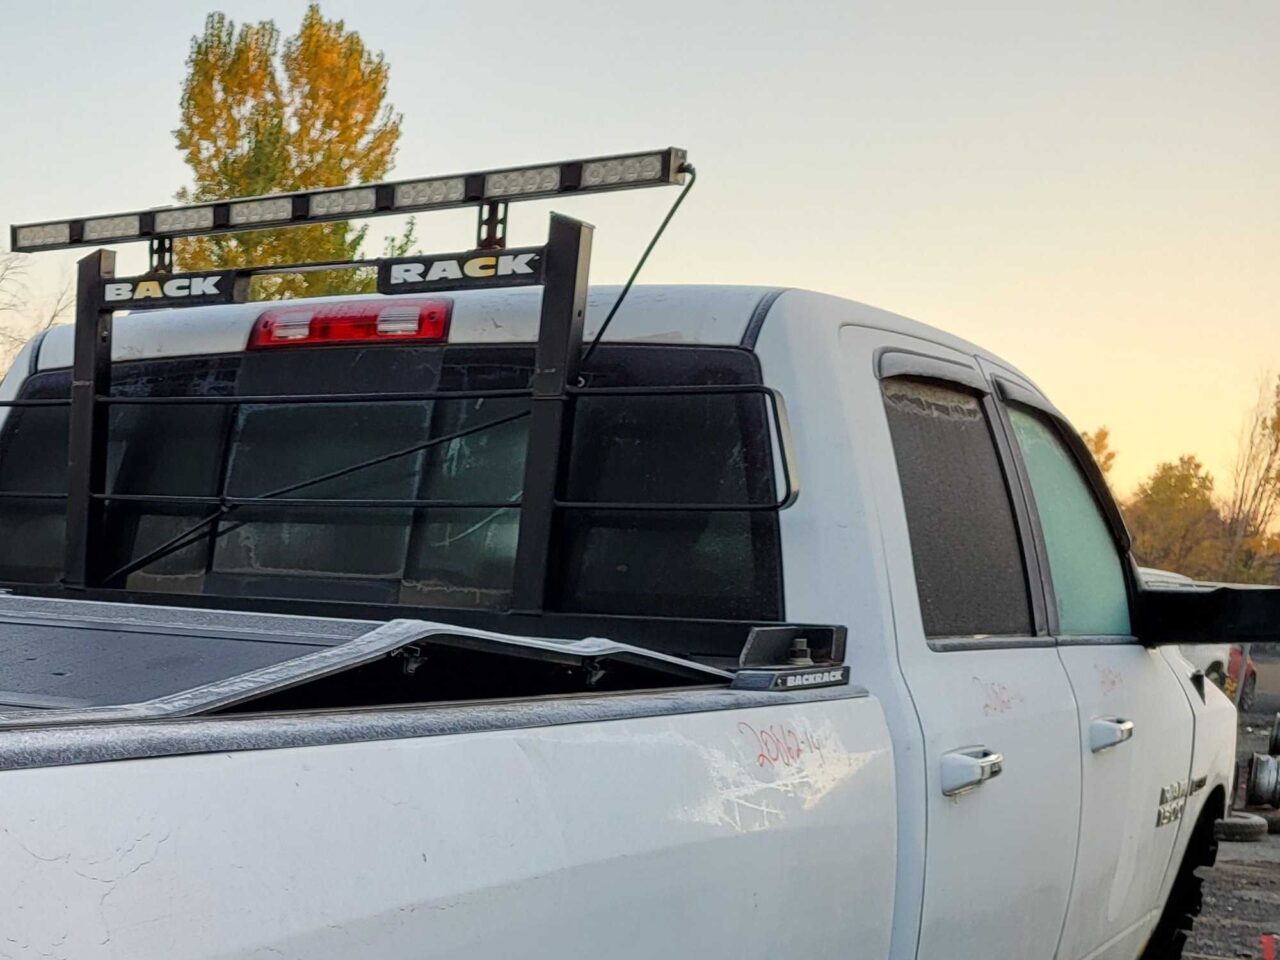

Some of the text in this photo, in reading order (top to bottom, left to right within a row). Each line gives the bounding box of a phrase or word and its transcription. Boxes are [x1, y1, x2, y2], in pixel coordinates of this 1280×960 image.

[389, 253, 536, 285] RACK
[104, 275, 222, 301] BACK
[786, 670, 844, 687] BACKRACK
